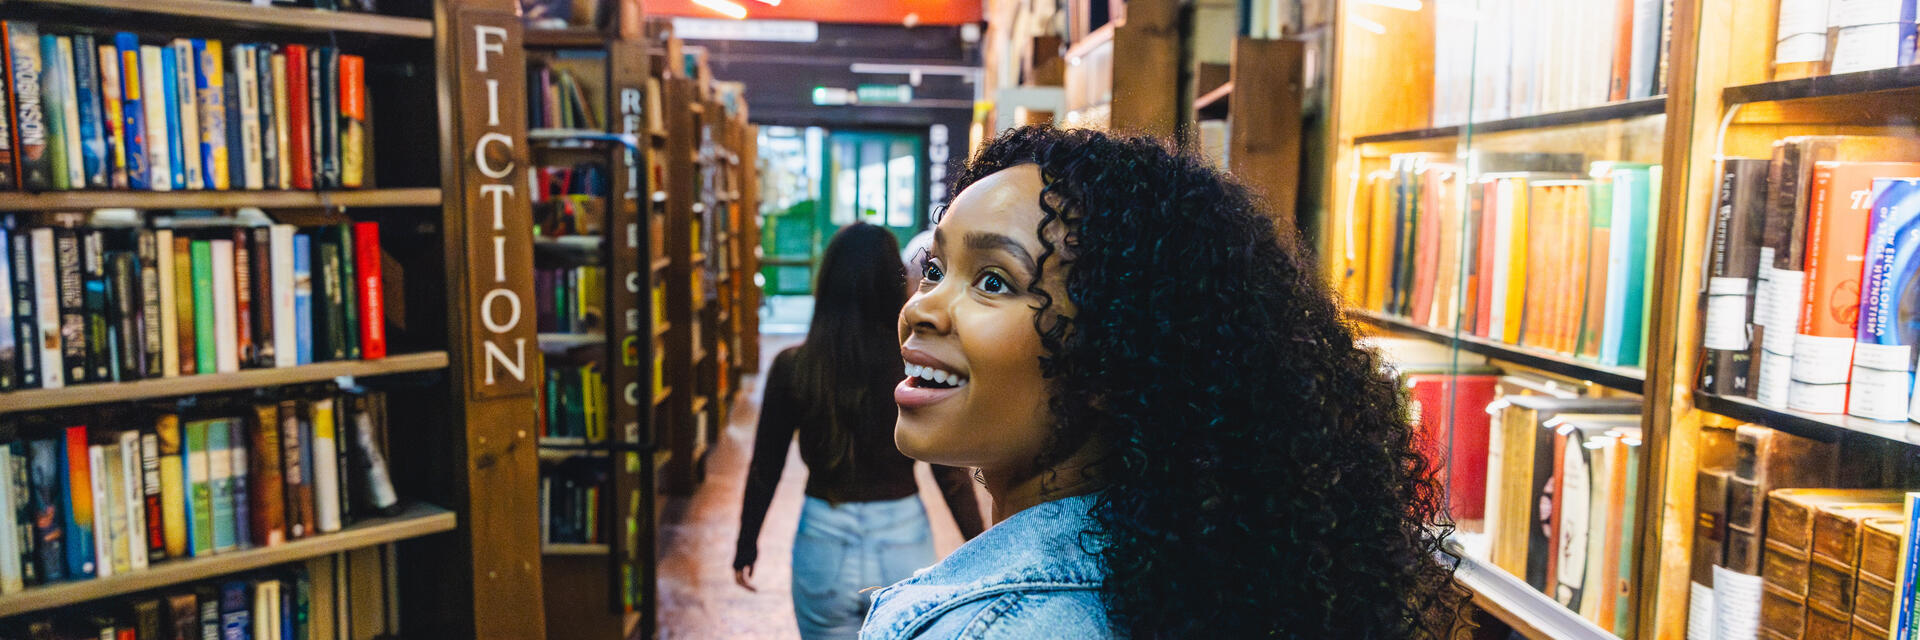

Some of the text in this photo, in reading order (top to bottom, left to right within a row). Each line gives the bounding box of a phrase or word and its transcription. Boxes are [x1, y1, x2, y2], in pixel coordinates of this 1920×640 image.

[474, 25, 526, 385] FICTION
[1866, 206, 1888, 334] OF STAGE HYPNOTISM
[1875, 247, 1896, 337] ENCYCLOPEDIA
